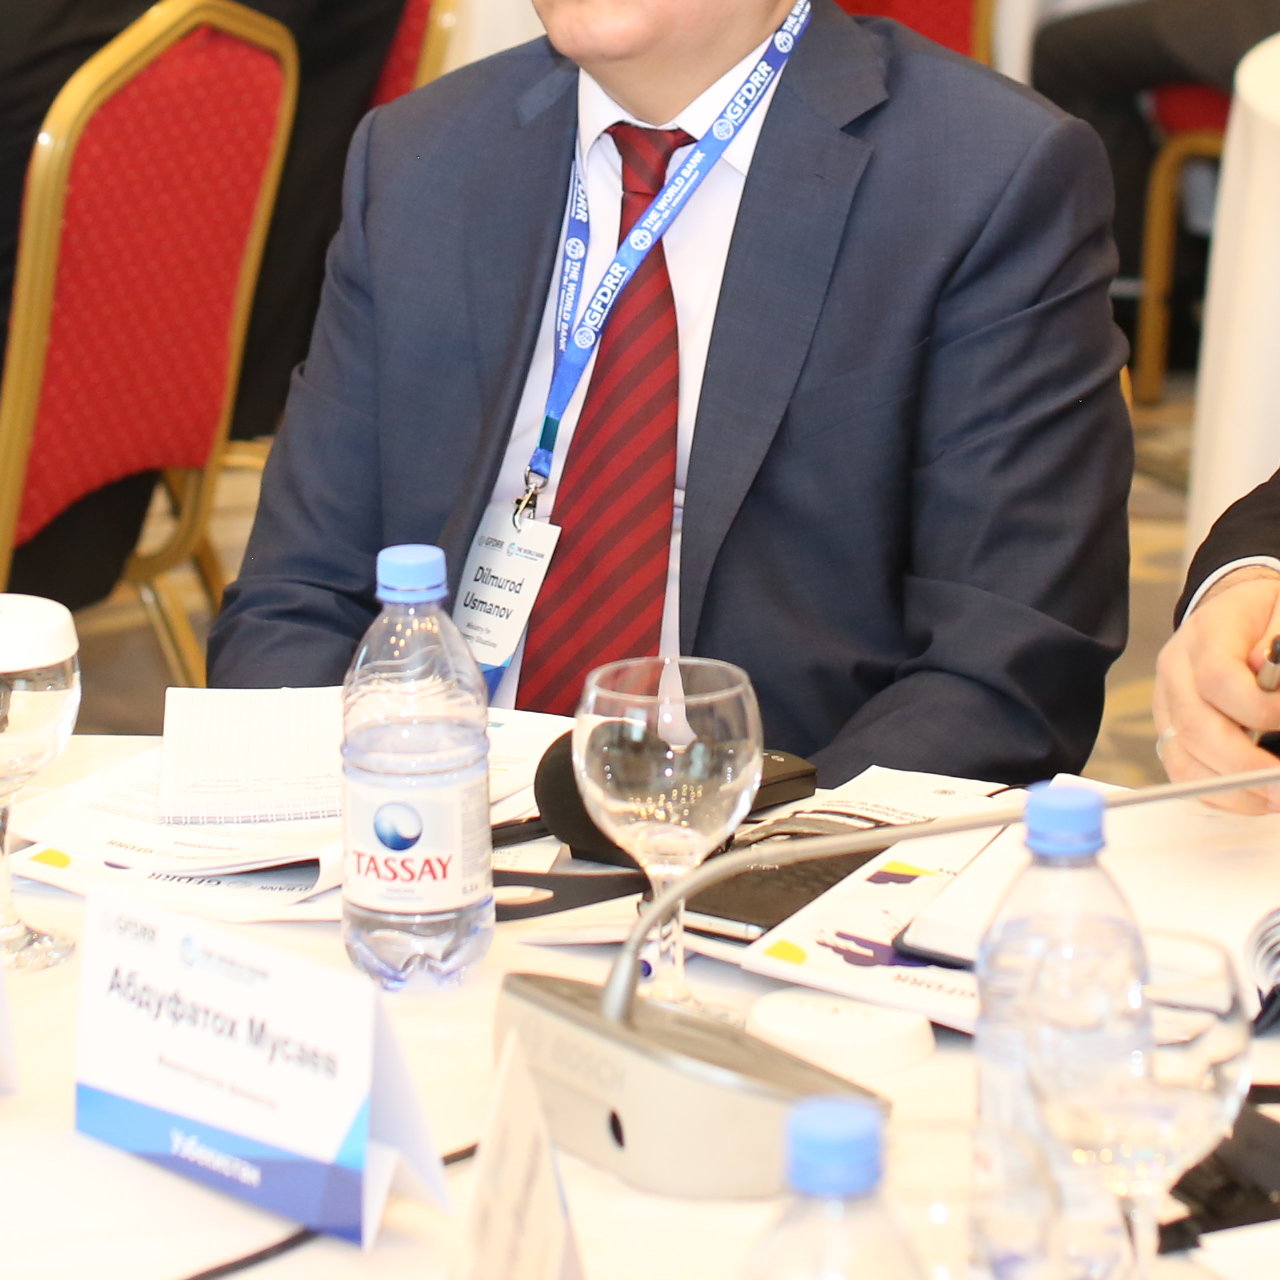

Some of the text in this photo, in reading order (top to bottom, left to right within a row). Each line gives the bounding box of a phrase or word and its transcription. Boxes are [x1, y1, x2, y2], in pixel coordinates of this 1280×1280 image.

[726, 61, 773, 121] GFDRR
[642, 209, 660, 230] THE
[655, 177, 685, 211] WORLD
[681, 150, 705, 177] BANK
[569, 260, 581, 280] THE
[563, 281, 577, 321] WORLD
[586, 262, 627, 328] GFDRR
[559, 320, 569, 351] BANK
[473, 566, 525, 594] Dilmurod
[463, 591, 514, 620] Usmanov
[148, 872, 222, 887] GFDRR
[352, 850, 453, 883] TASSAY
[107, 966, 340, 1079] Абдуфатох Мусаев
